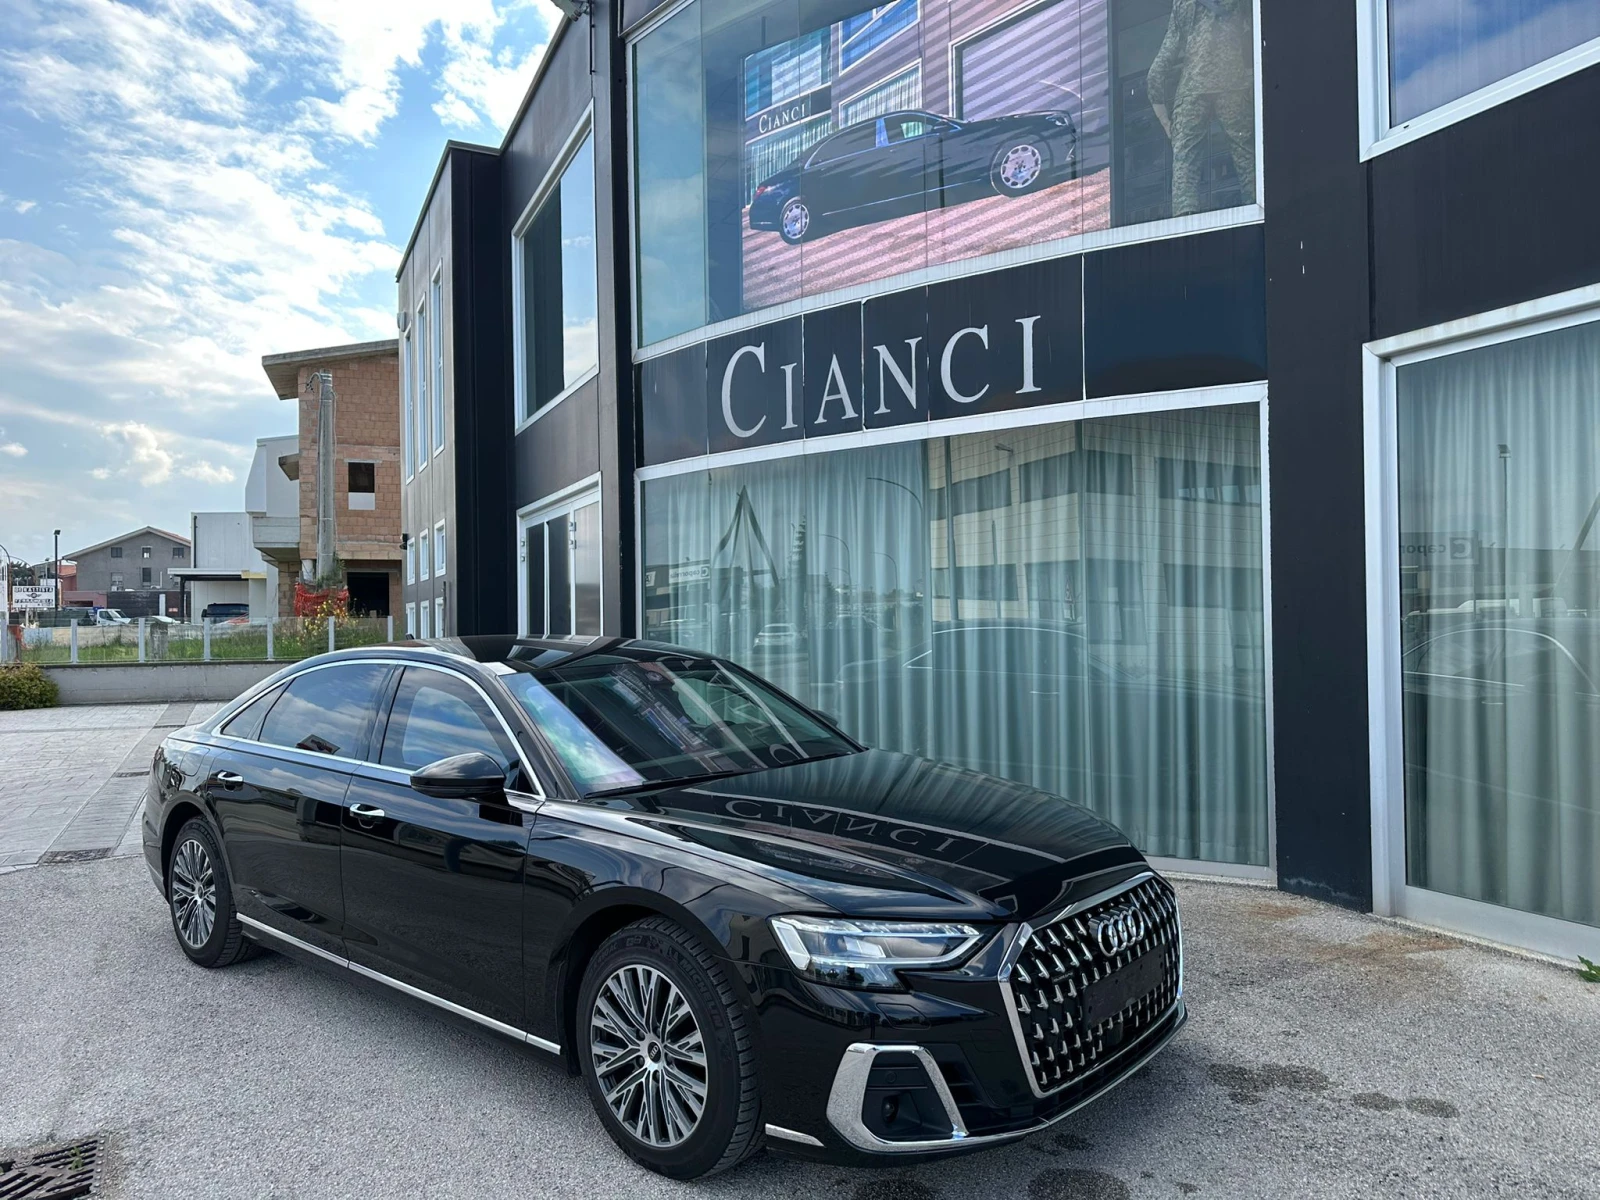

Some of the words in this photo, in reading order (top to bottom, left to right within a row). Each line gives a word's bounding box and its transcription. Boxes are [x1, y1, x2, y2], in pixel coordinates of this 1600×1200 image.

[758, 103, 806, 134] CIANCI
[721, 314, 1042, 438] CIANCI
[679, 957, 725, 1031] MICHELIN
